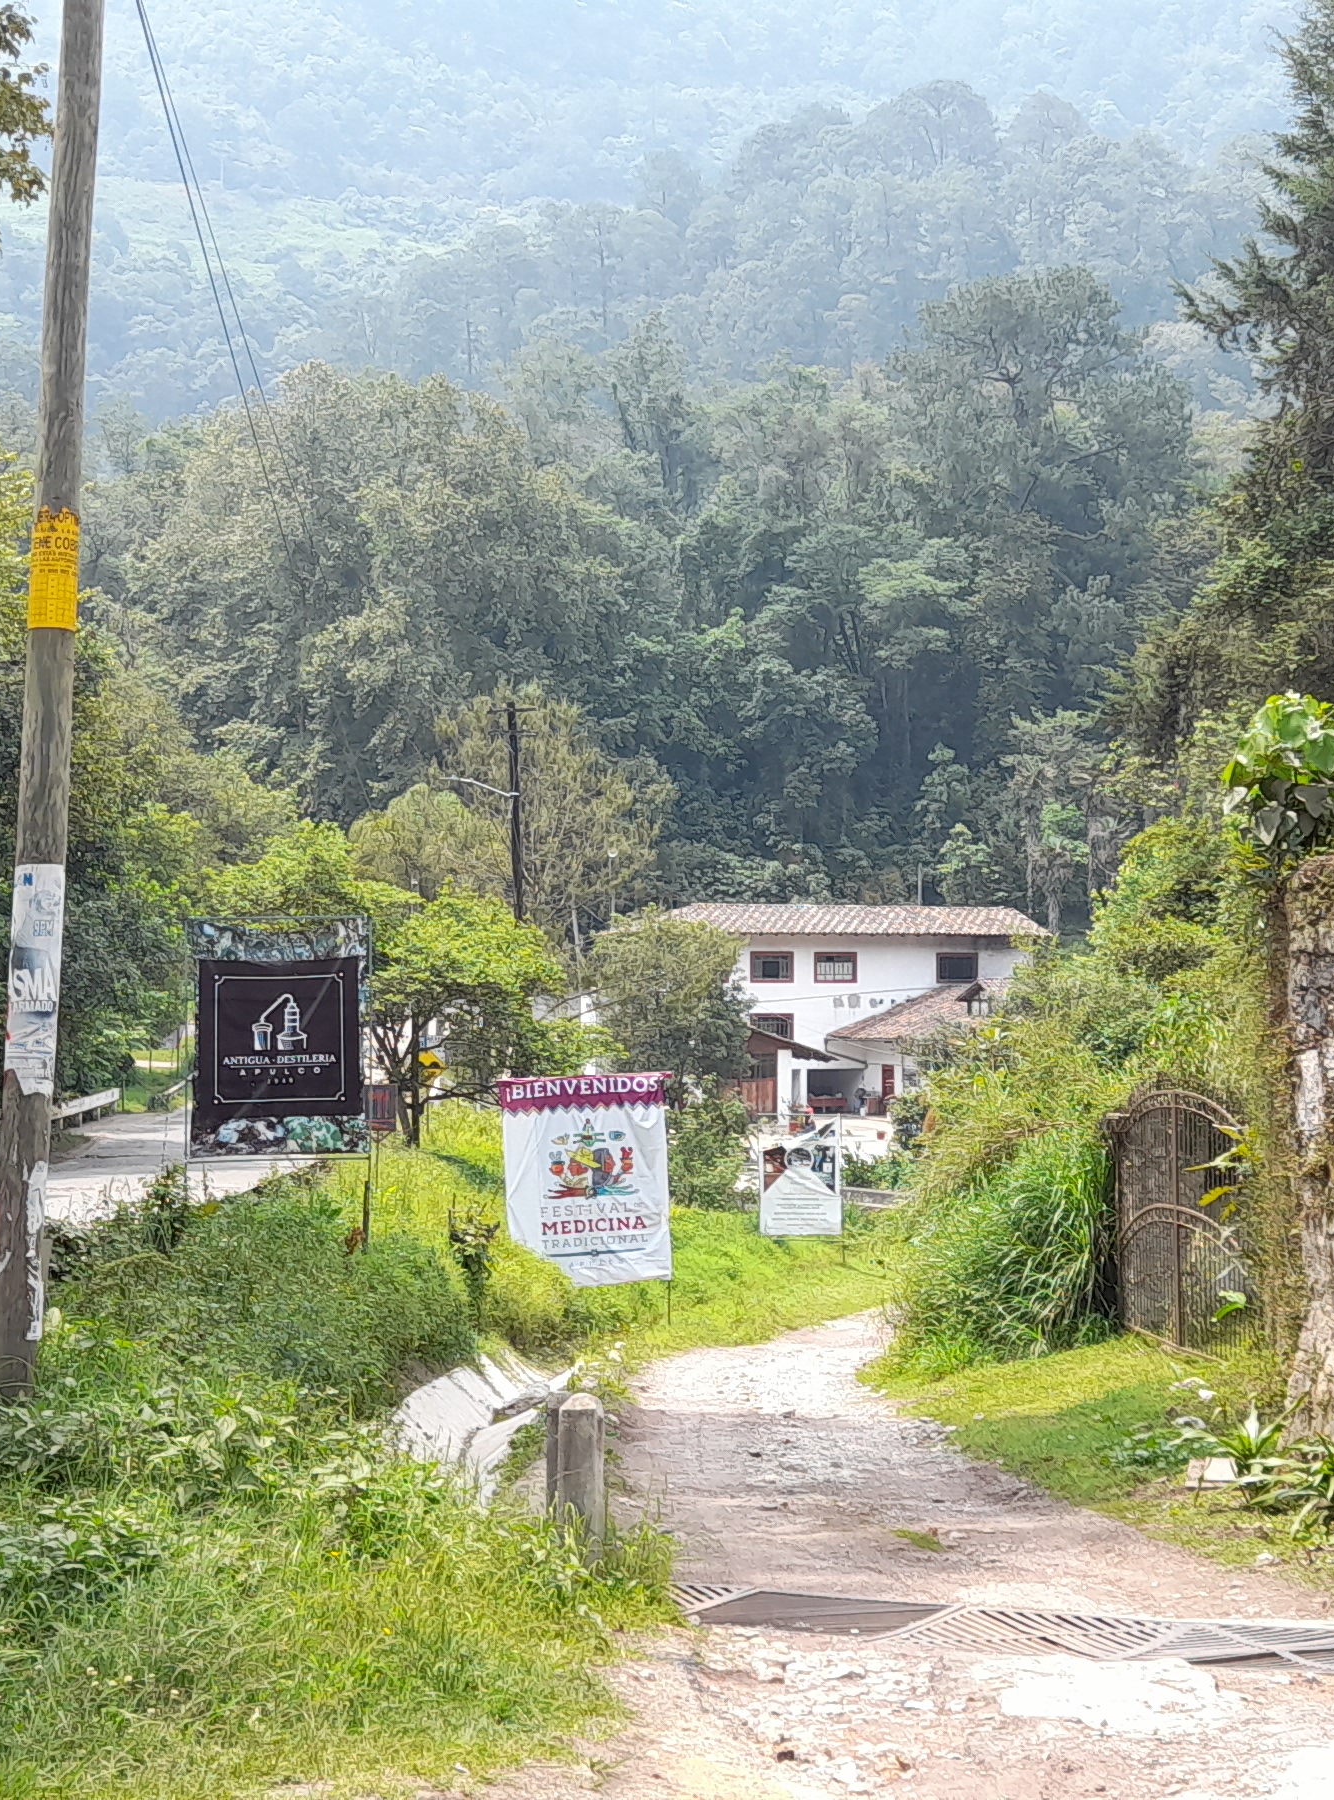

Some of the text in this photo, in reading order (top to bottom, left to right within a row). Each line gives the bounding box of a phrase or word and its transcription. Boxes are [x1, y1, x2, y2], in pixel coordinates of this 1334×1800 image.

[223, 1054, 336, 1065] ANTIGUA DESTILERIA
[239, 1067, 321, 1076] APULCO
[540, 1202, 632, 1218] FESTIVAL
[542, 1216, 647, 1235] MEDICINA
[542, 1234, 648, 1249] TRADICIONAL
